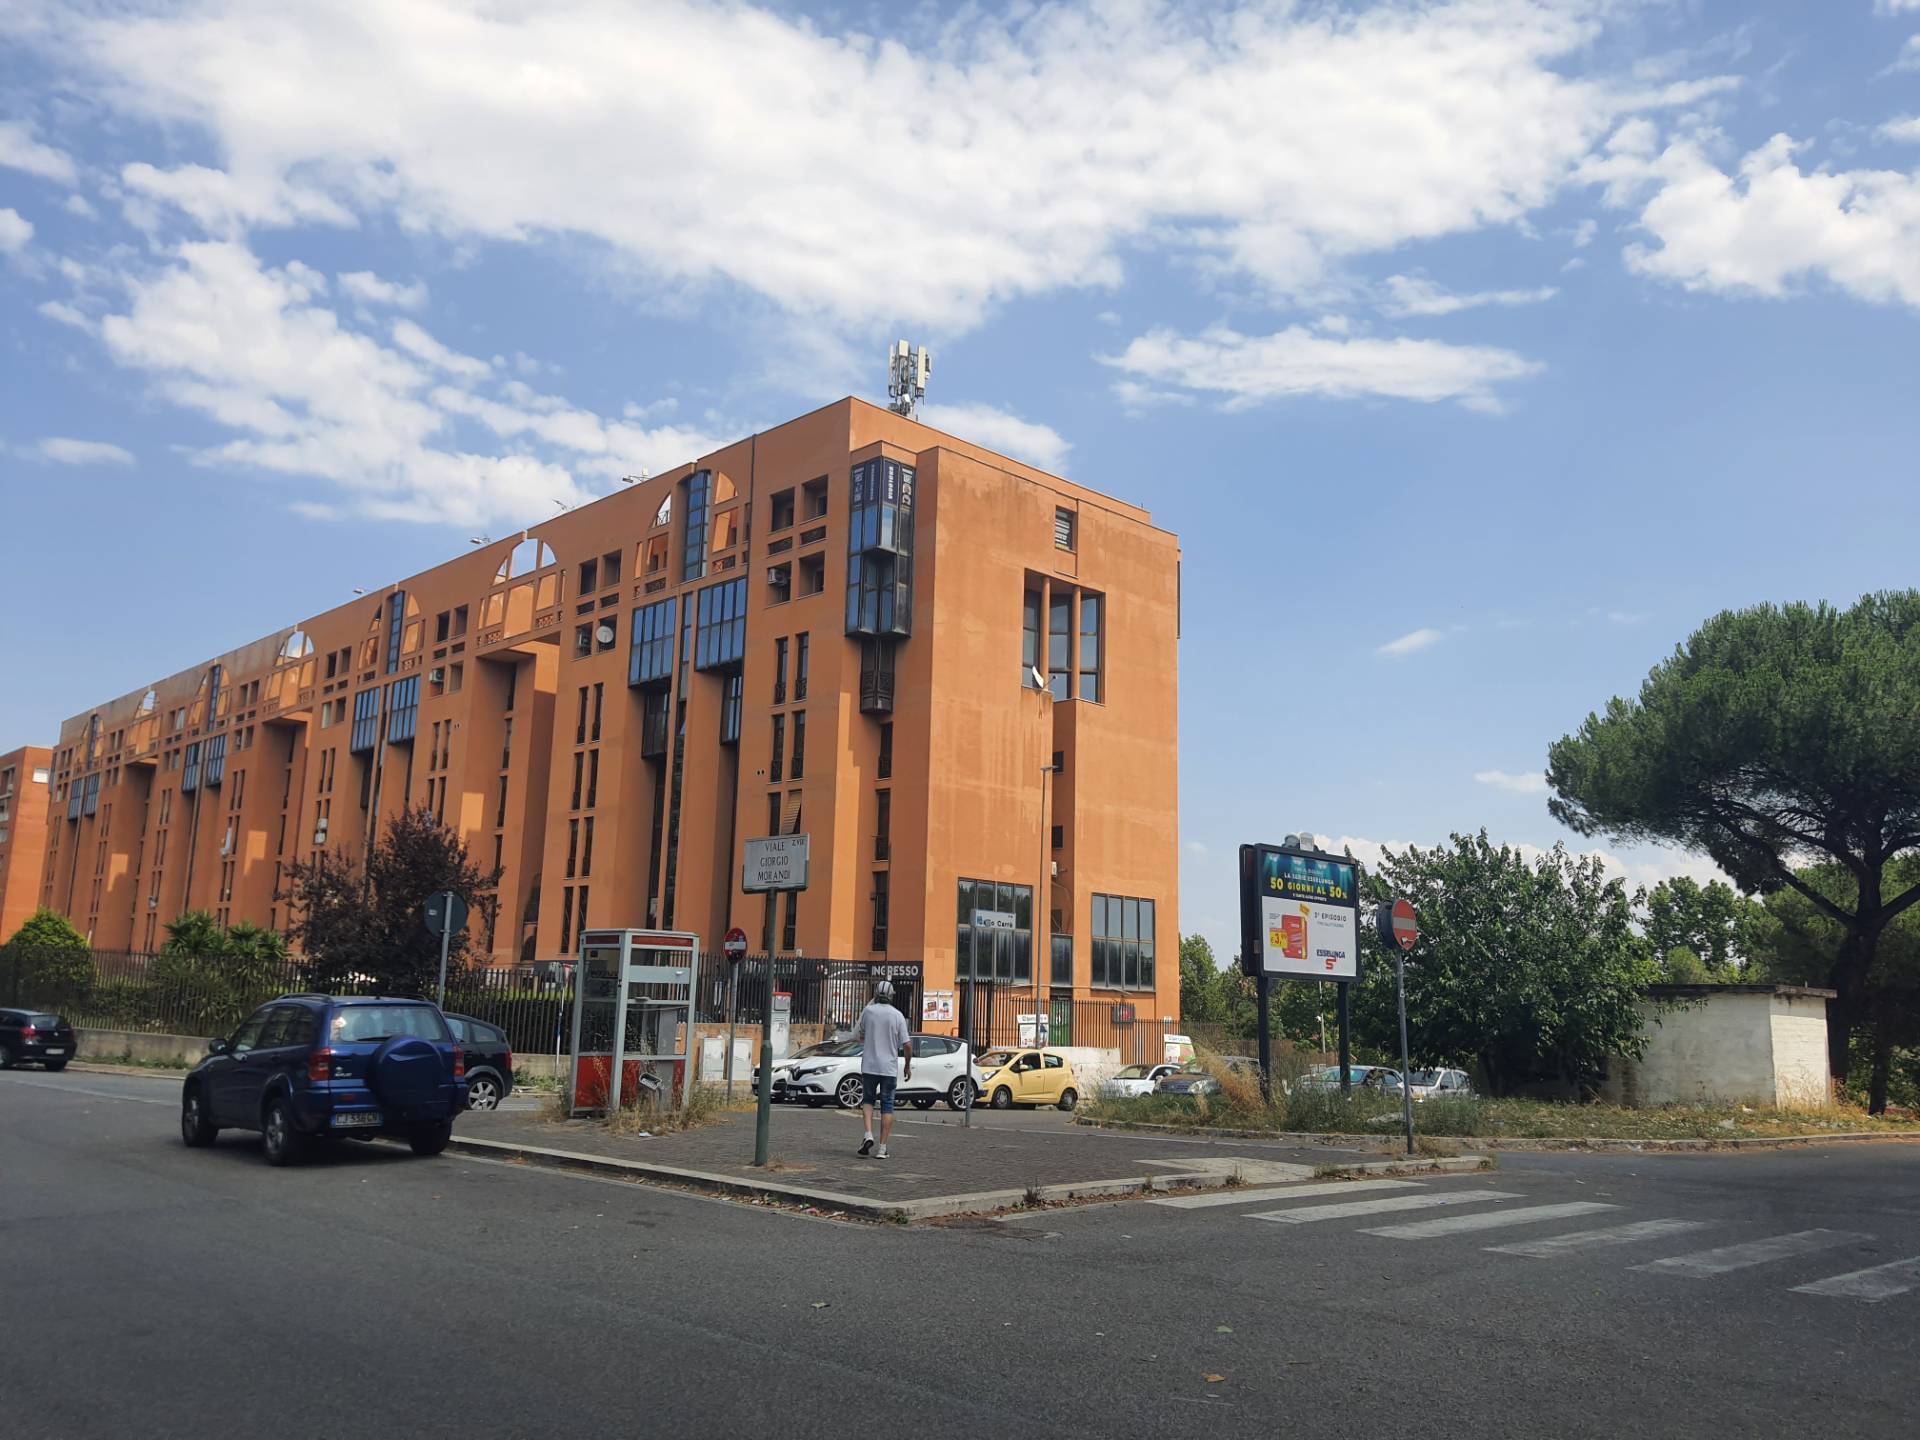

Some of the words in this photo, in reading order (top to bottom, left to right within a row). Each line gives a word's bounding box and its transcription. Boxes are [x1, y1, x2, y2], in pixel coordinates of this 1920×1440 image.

[765, 841, 785, 852] VIALE
[760, 855, 789, 867] GIORGIO
[757, 869, 791, 881] MORANDI
[1270, 877, 1284, 890] 50
[1287, 881, 1314, 893] GIORNI
[1316, 885, 1326, 895] AL
[1321, 912, 1347, 922] EPISODIO
[1316, 949, 1345, 959] ESSELUNGA
[871, 965, 919, 976] INGRESSO
